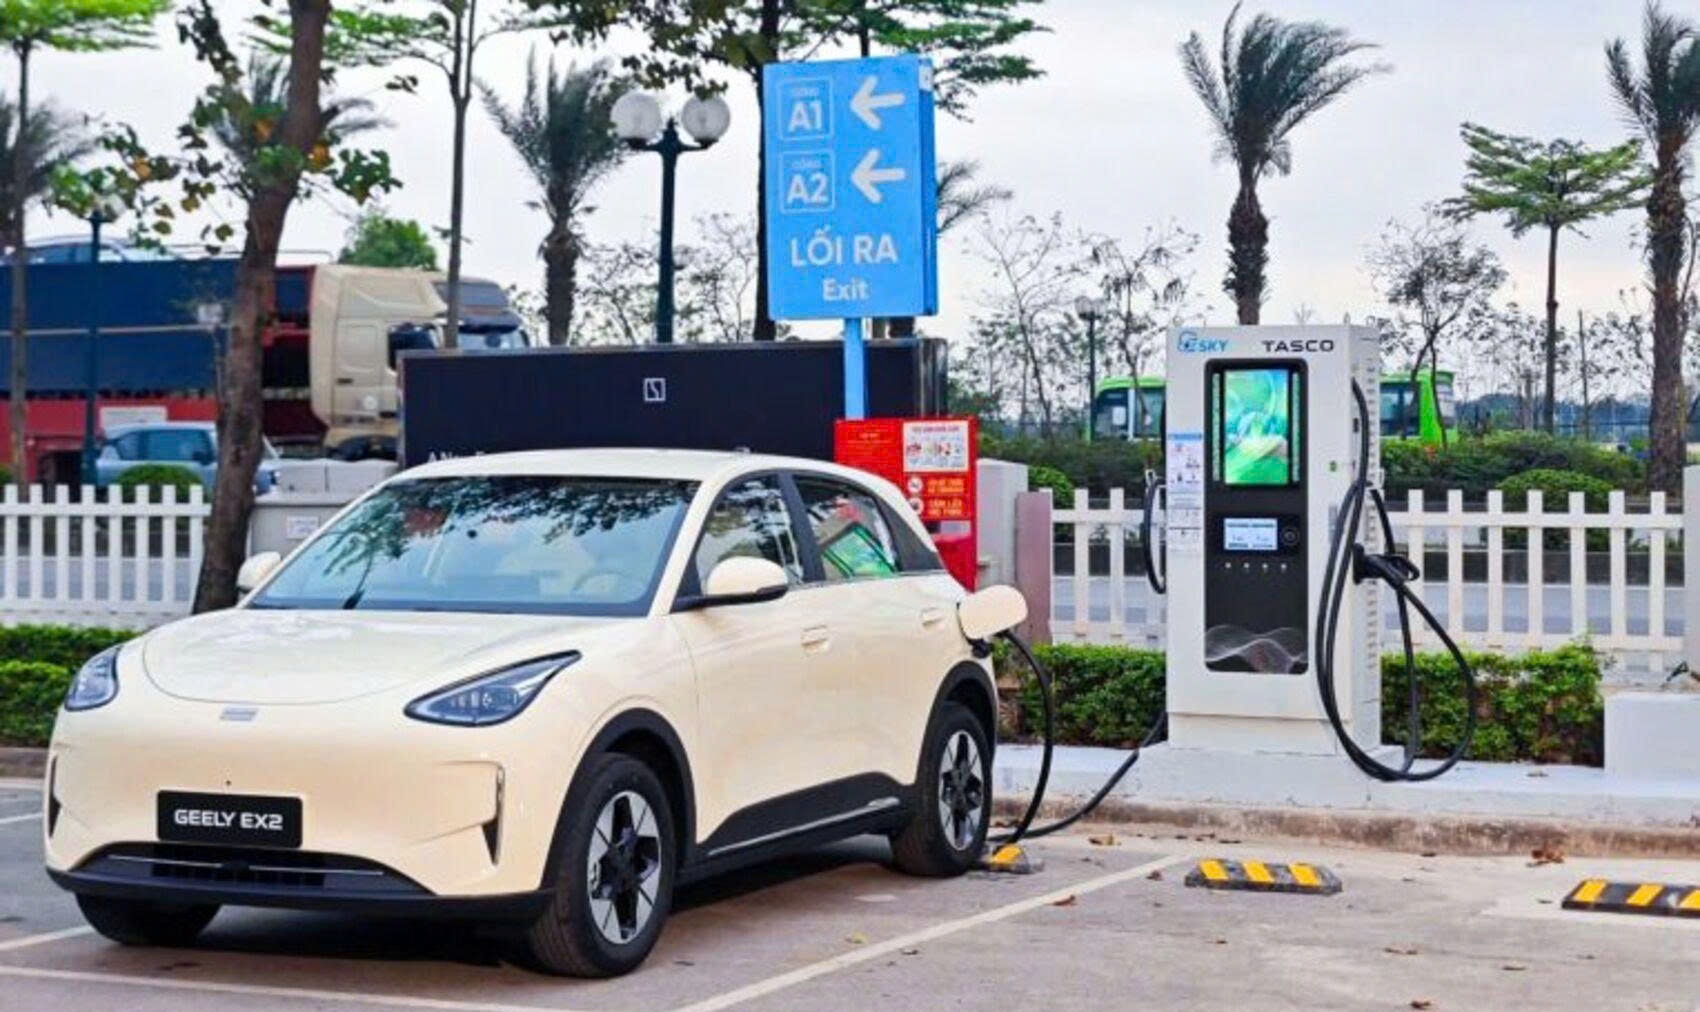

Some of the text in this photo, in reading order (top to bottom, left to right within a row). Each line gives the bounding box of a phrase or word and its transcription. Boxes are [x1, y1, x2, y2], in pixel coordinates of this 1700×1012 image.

[788, 101, 822, 132] A1
[787, 173, 828, 204] A2
[791, 225, 898, 267] LỐI RA
[823, 277, 869, 301] Exit
[1262, 339, 1335, 352] TASCO
[174, 809, 283, 831] GEELY EX2
